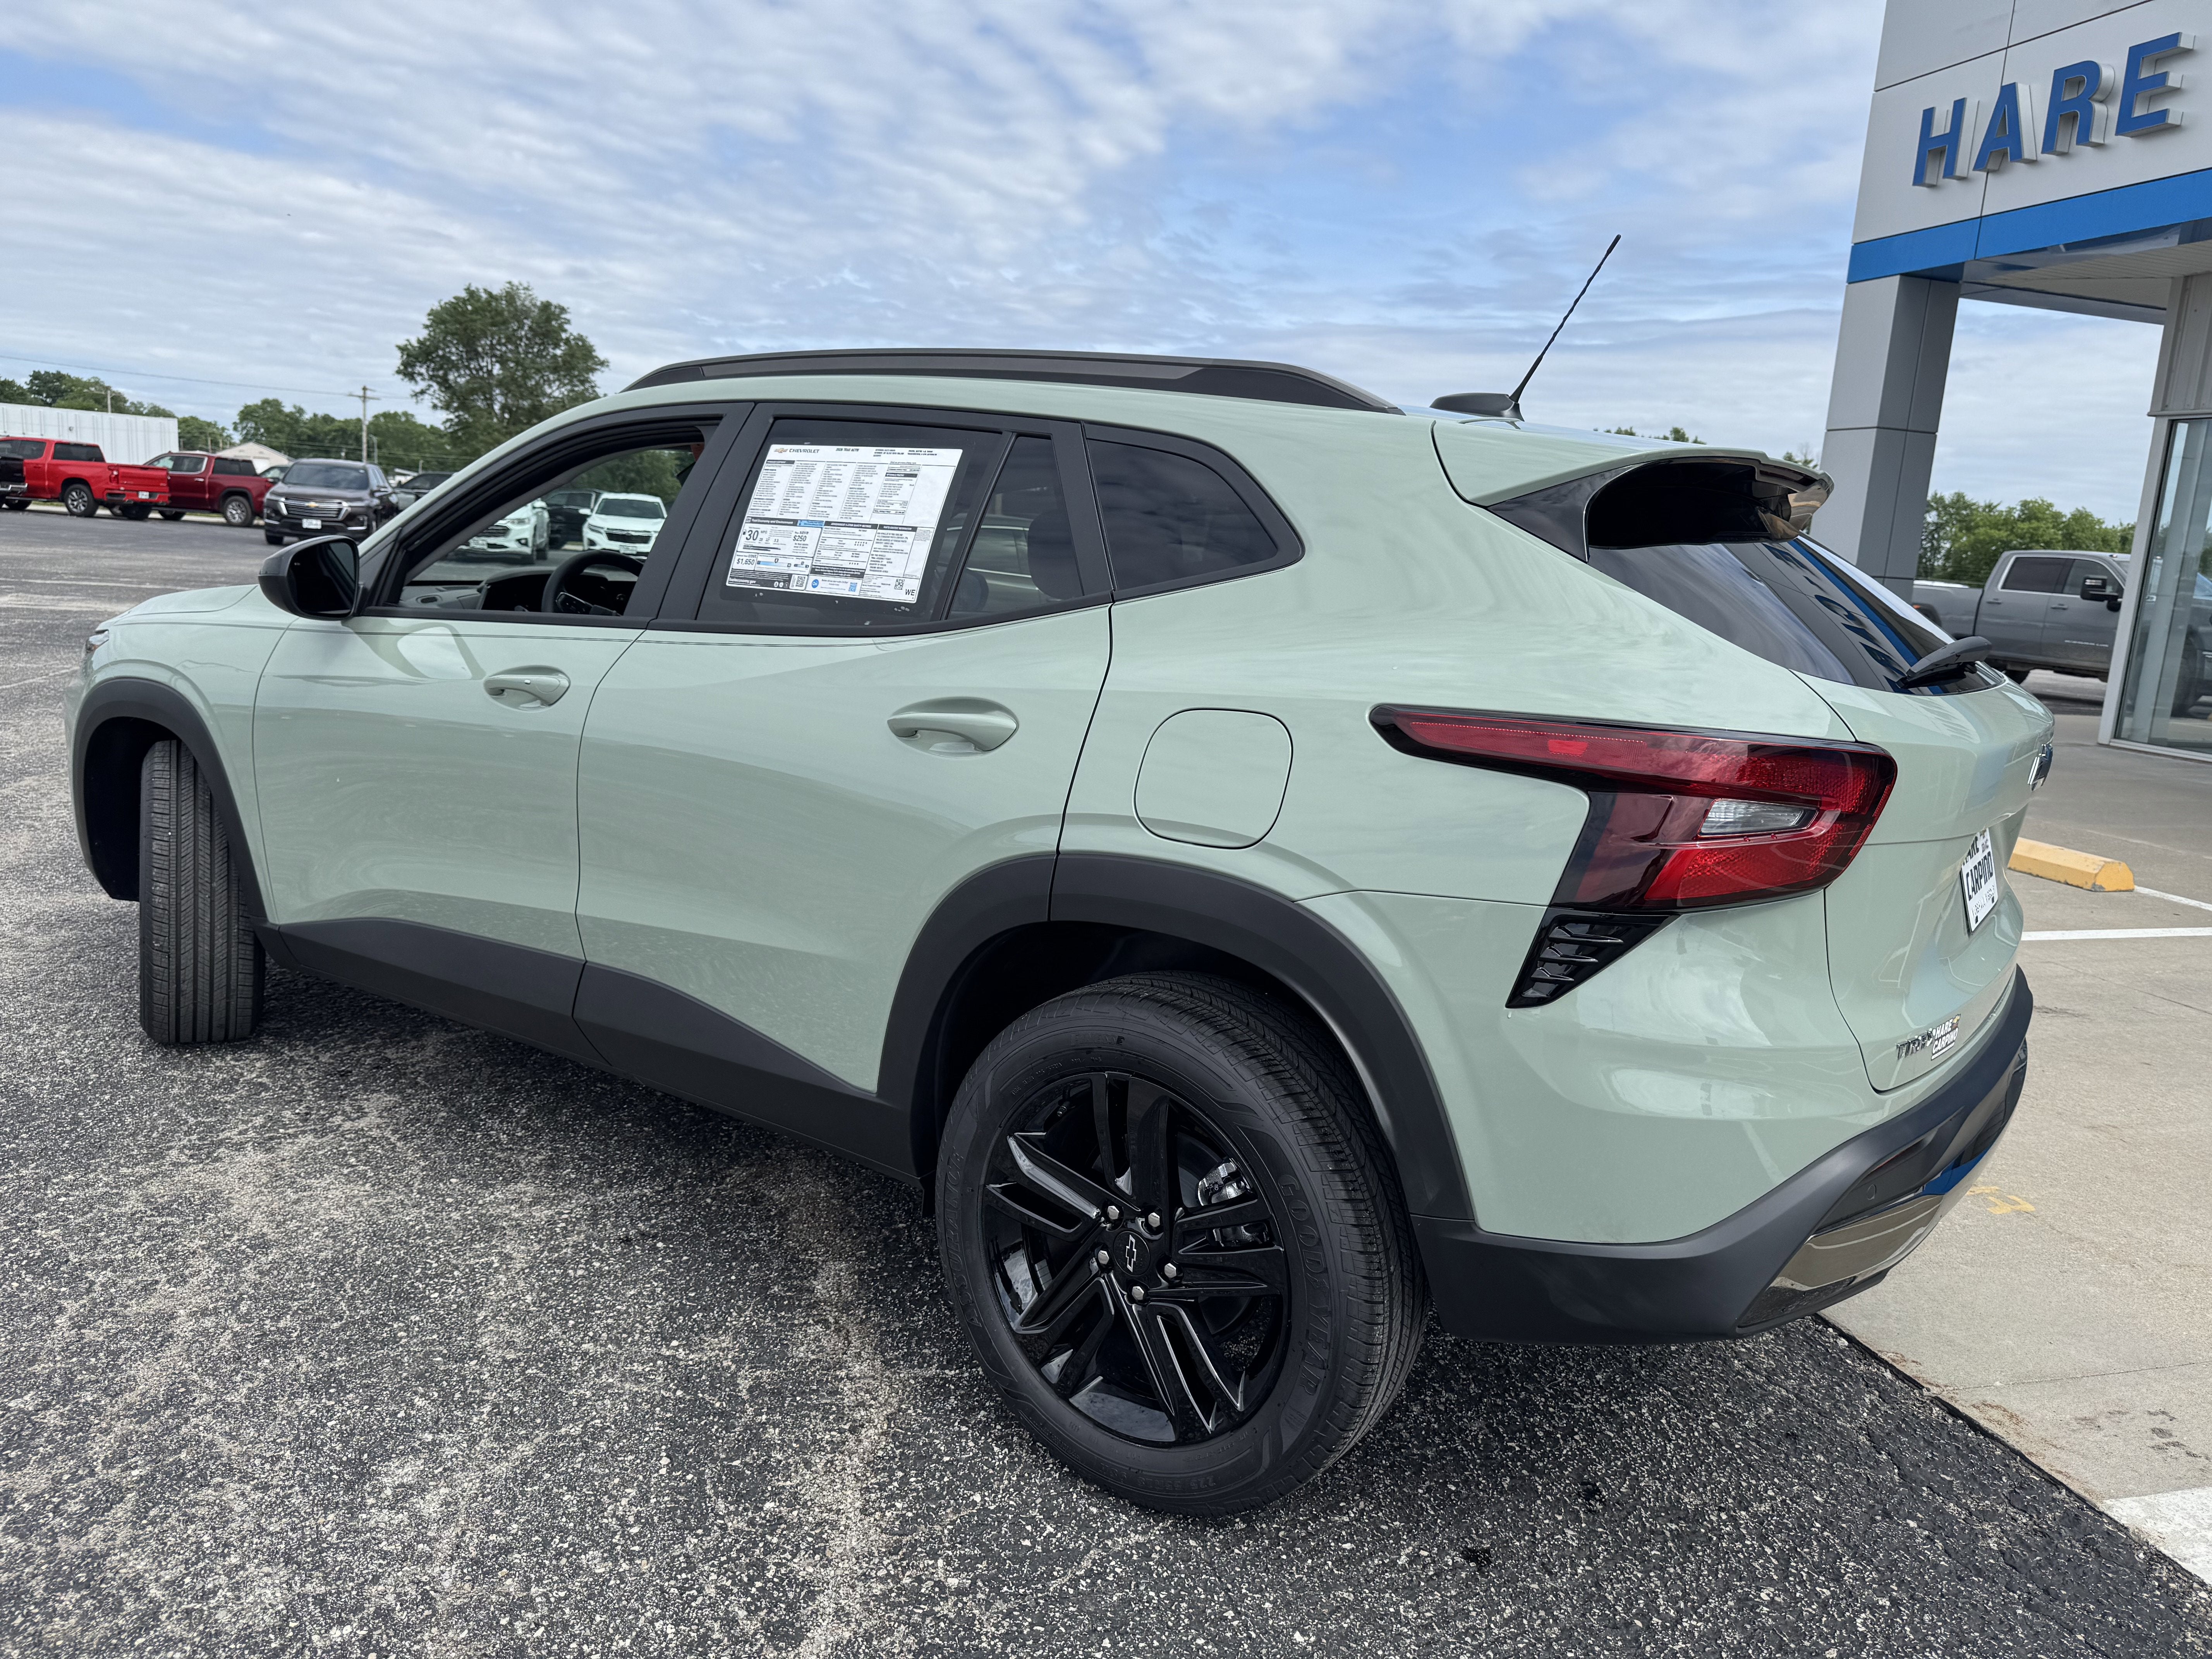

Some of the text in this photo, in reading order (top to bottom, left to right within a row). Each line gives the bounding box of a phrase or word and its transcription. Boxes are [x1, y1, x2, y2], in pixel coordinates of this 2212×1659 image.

[1912, 32, 2195, 187] HARE
[746, 530, 759, 541] 30
[1966, 851, 1994, 902] CARPINO
[1932, 1027, 1959, 1054] CARPINO
[1935, 1018, 1953, 1040] HARE
